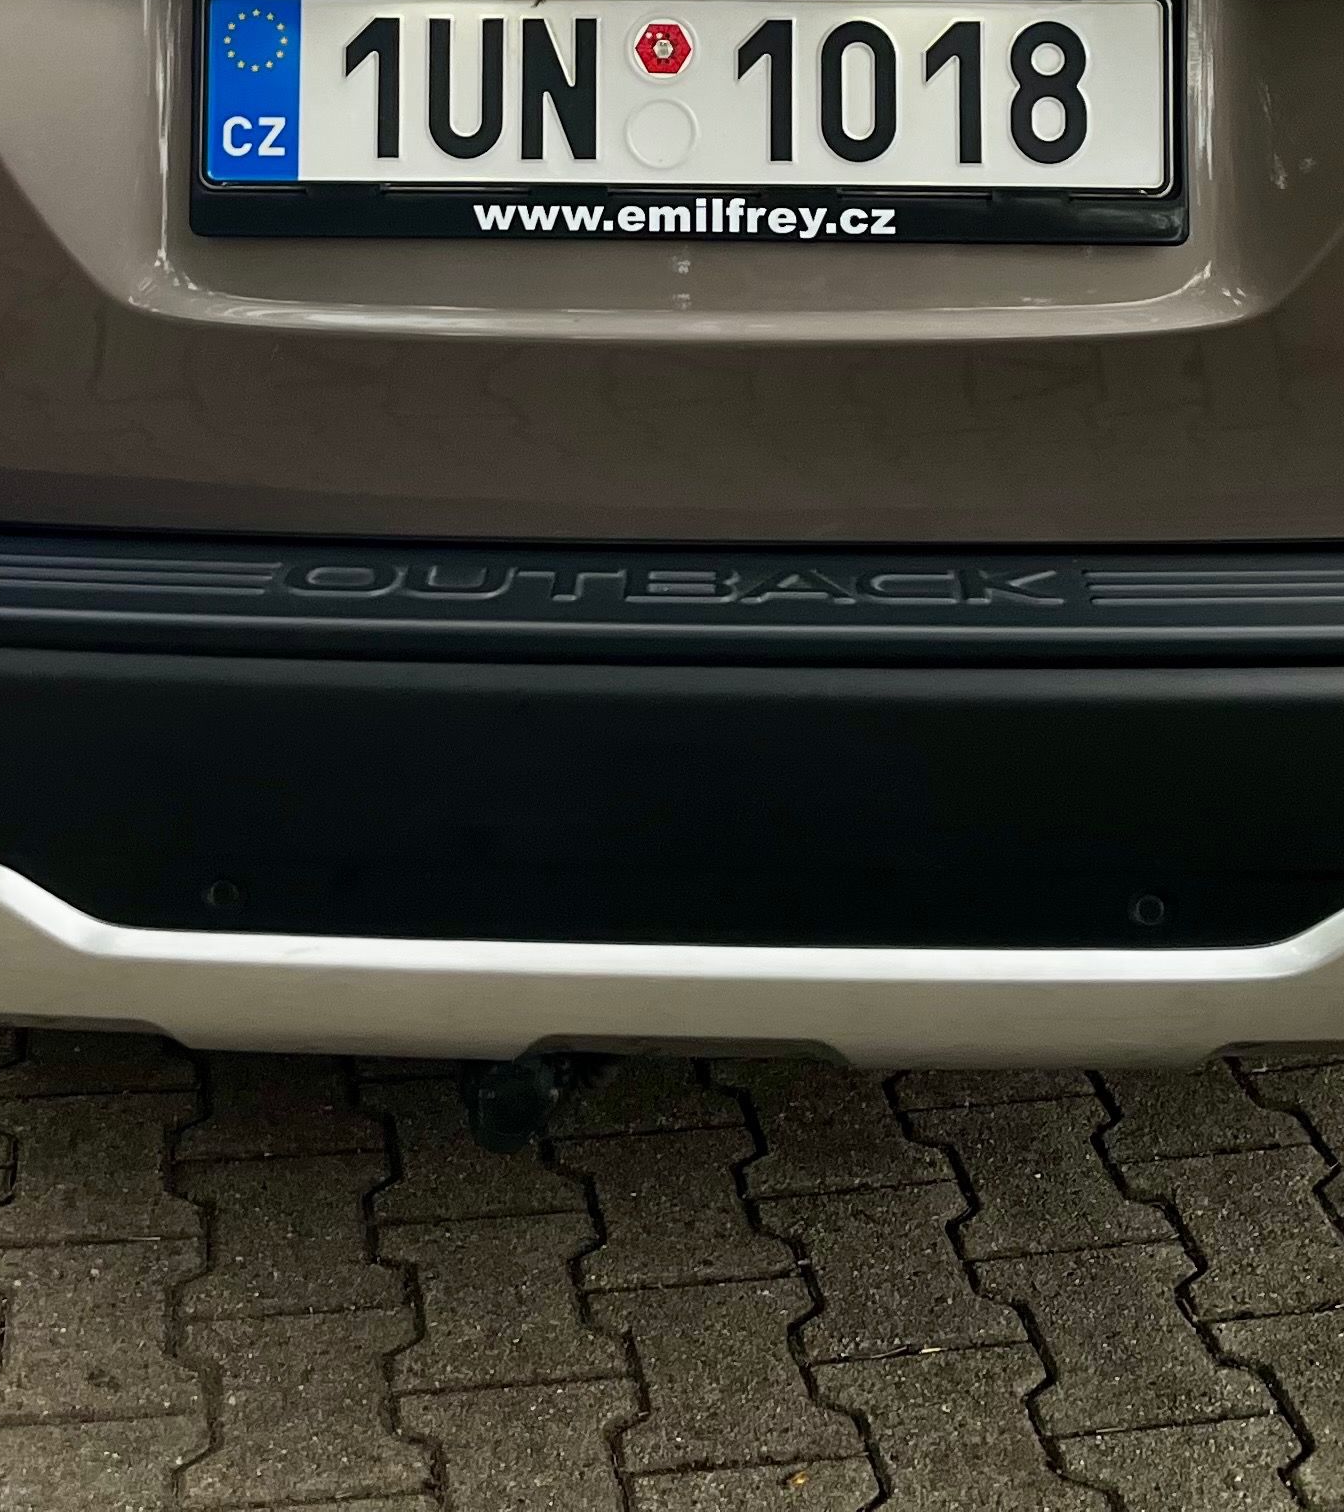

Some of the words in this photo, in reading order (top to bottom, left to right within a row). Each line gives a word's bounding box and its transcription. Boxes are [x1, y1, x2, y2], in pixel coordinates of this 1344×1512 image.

[344, 17, 597, 160] 1UN
[736, 19, 1087, 164] 1018
[222, 115, 286, 157] CZ
[473, 198, 896, 239] www.emilfrey.cz
[283, 563, 1067, 606] OUTBACK
